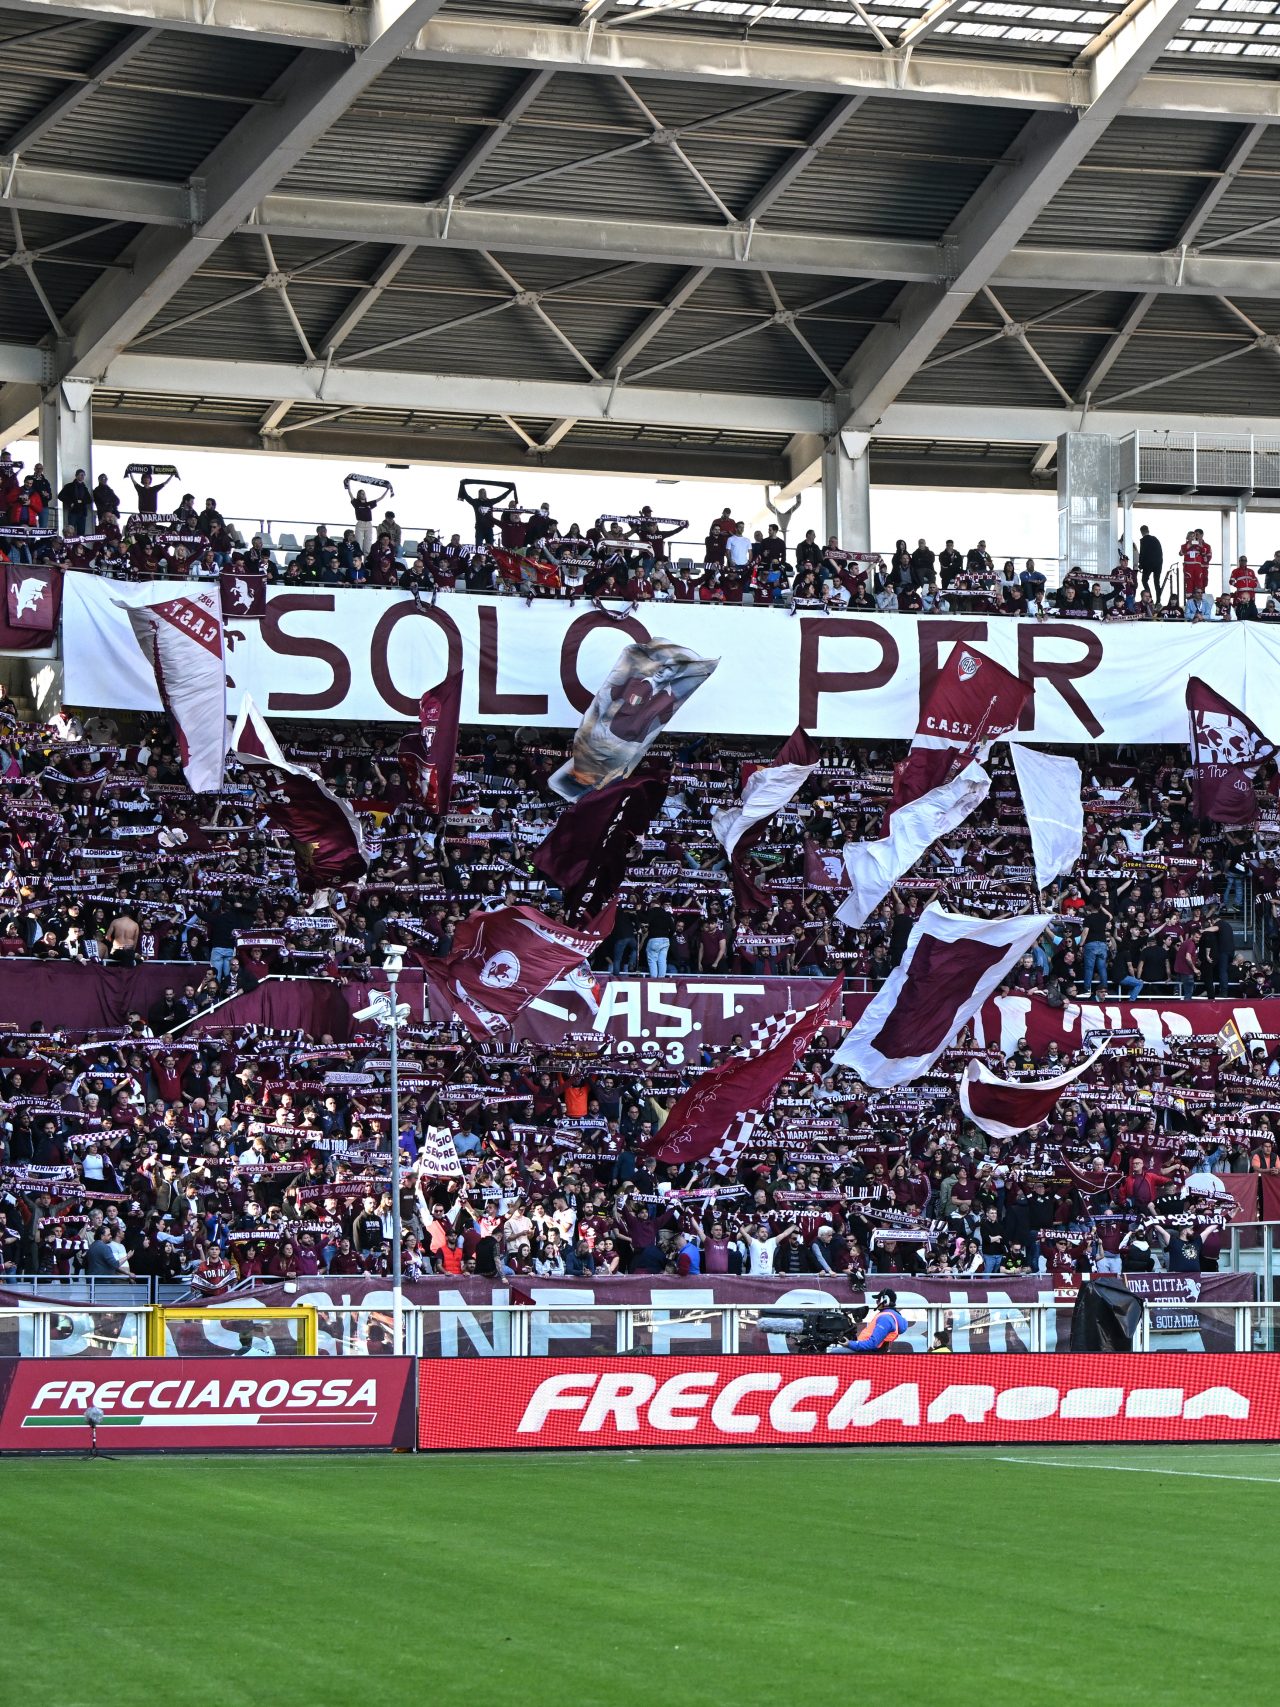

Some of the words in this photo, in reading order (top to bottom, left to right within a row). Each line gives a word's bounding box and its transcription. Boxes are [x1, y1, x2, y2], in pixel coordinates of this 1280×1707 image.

[799, 618, 1106, 738] PER
[926, 716, 973, 736] C.A.S.T.
[687, 781, 707, 789] FORZA
[708, 781, 727, 789] TORO
[471, 864, 505, 872] TORINO
[661, 867, 679, 876] TORO
[88, 895, 114, 903] TORINO
[1173, 897, 1189, 907] FORZA
[1190, 896, 1204, 906] TORO
[1223, 1074, 1243, 1084] ULTRAS
[1253, 1078, 1280, 1089] GRANATA
[827, 1094, 857, 1103] TORINO
[775, 1131, 785, 1139] LA
[332, 1139, 347, 1150] TORO
[441, 1161, 460, 1171] NOI
[719, 1187, 739, 1195] TORINO
[780, 1210, 819, 1218] TORINO
[884, 1214, 919, 1224] MARATONA
[1045, 1232, 1084, 1240] GRANATA
[1127, 1280, 1150, 1292] UNA
[1156, 1315, 1199, 1328] SQUADRA
[34, 1379, 378, 1410] FRECCIAROSSA
